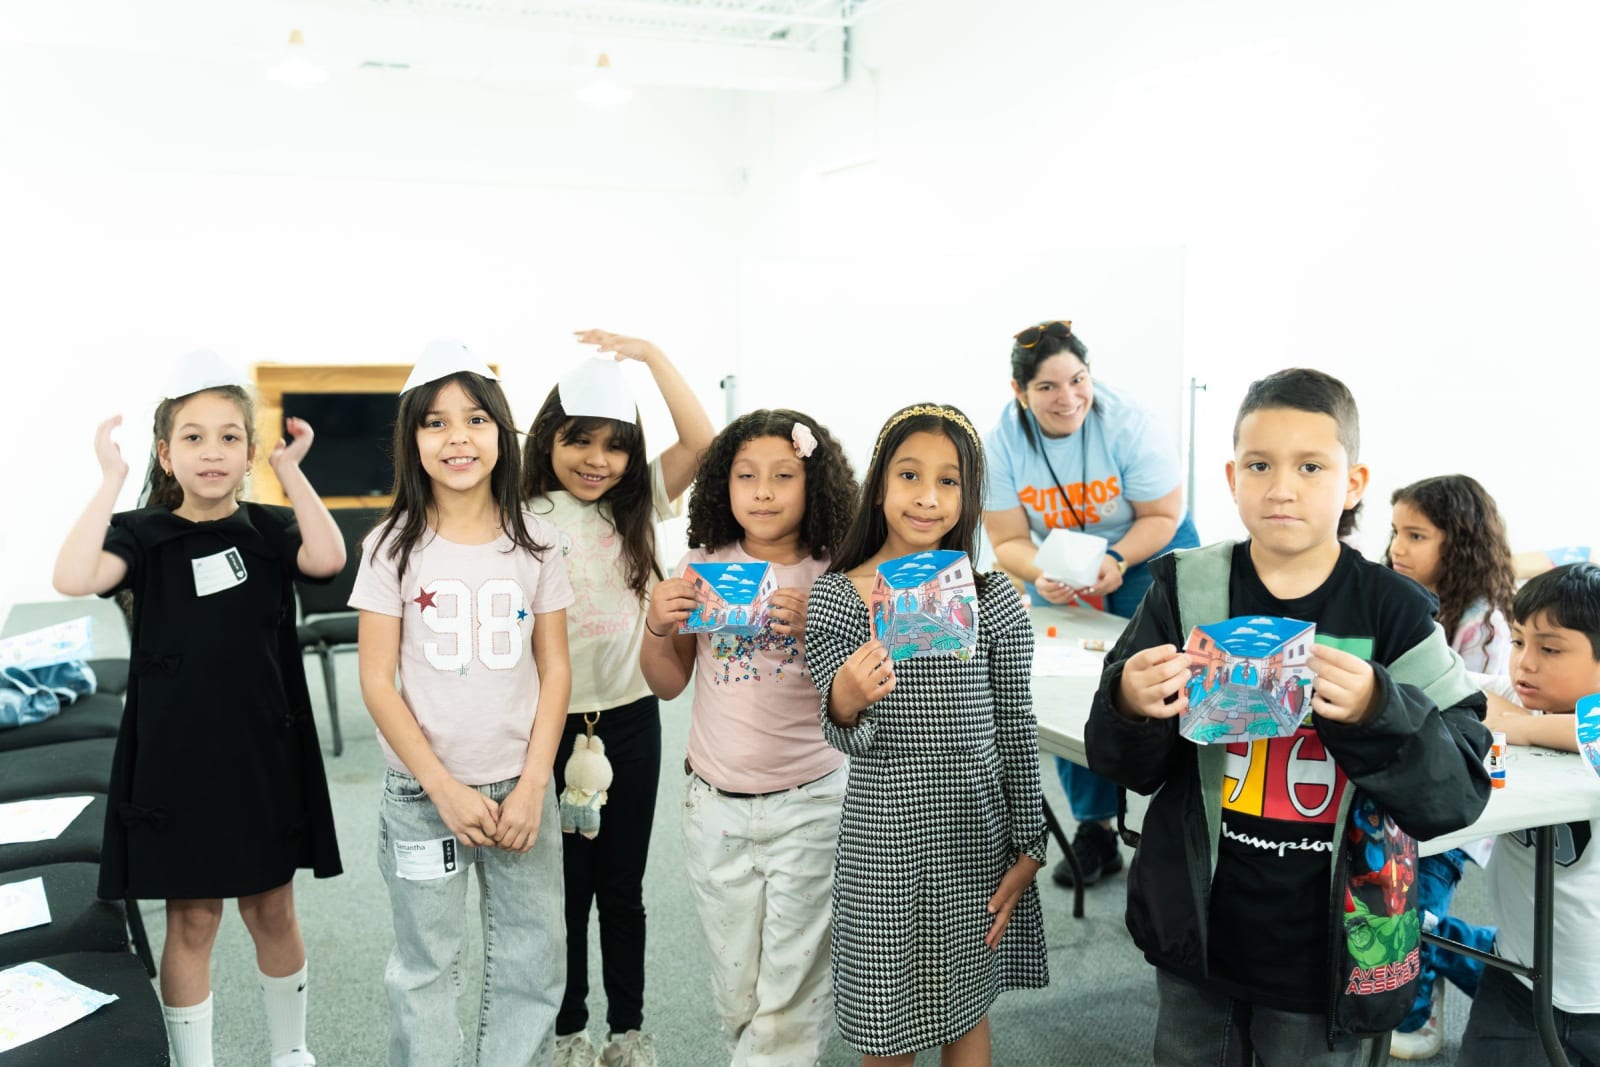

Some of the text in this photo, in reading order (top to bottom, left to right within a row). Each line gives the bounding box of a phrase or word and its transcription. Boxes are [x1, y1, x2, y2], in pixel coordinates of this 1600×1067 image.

[1043, 504, 1101, 530] KIDS
[422, 579, 523, 671] 98
[1222, 821, 1333, 857] hampio
